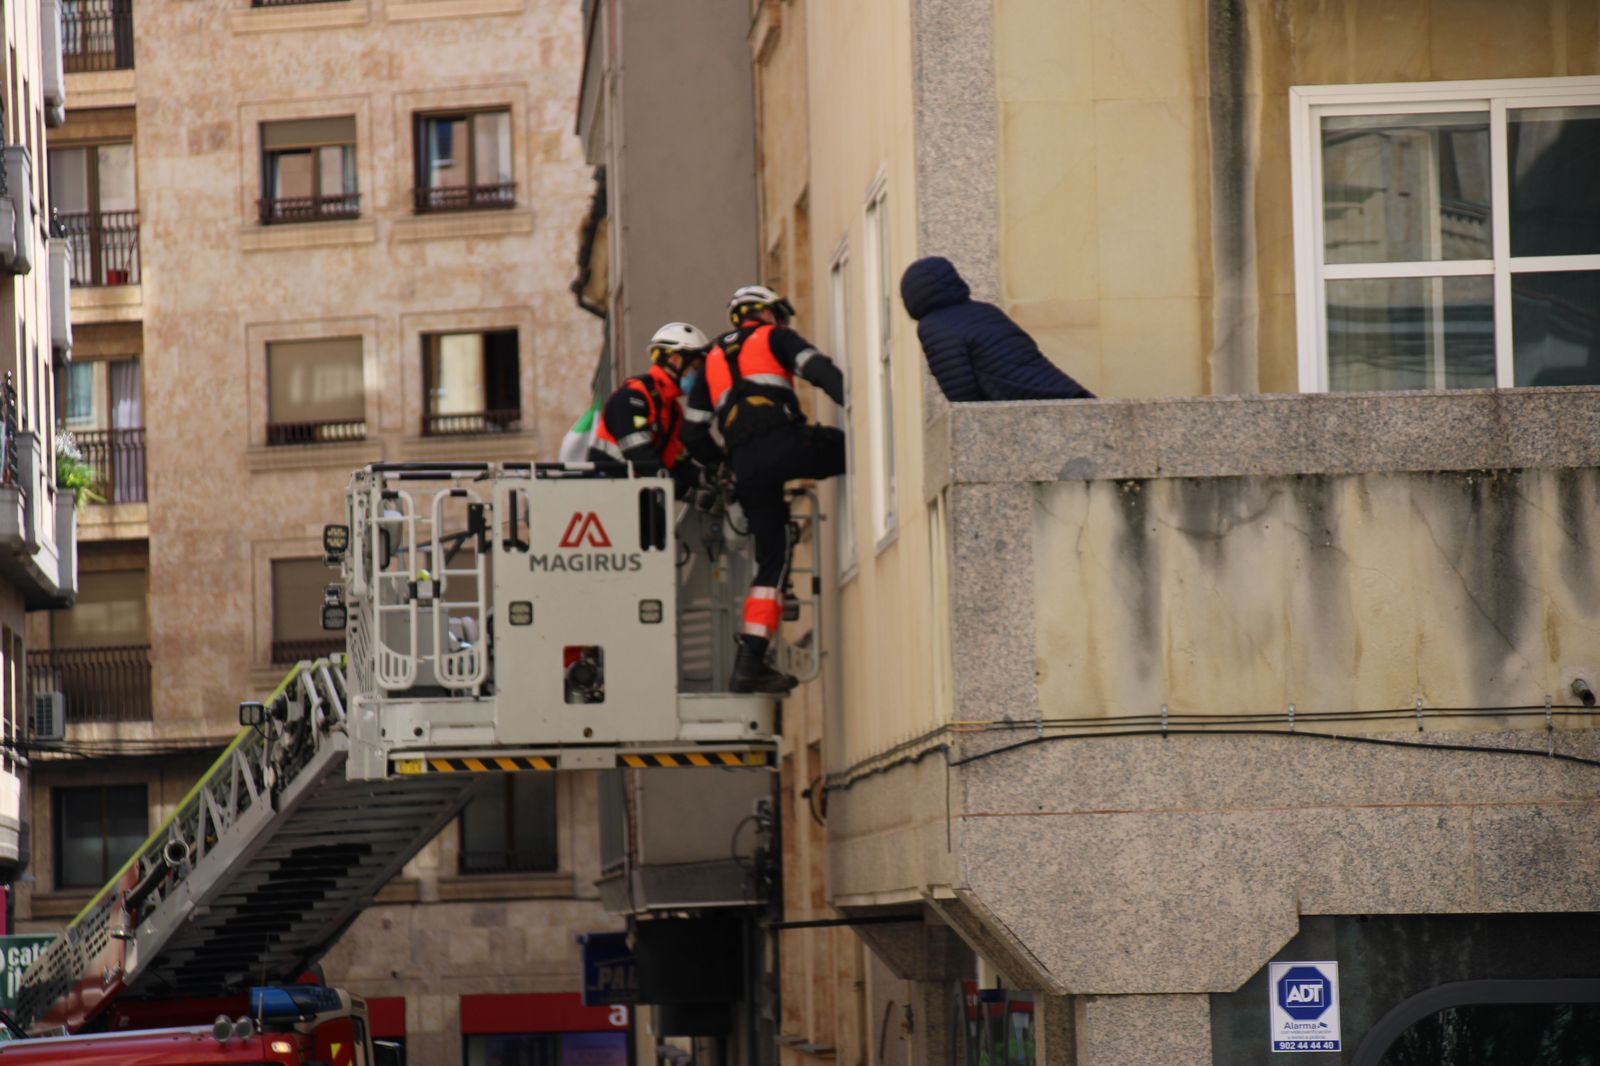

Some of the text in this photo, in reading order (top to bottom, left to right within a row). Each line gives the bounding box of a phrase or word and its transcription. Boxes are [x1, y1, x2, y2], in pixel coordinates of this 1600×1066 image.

[529, 553, 642, 572] MAGIRUS
[1286, 984, 1324, 1003] ADT
[1284, 1022, 1317, 1030] Alarma
[1279, 1041, 1334, 1050] 902 44 44 40
